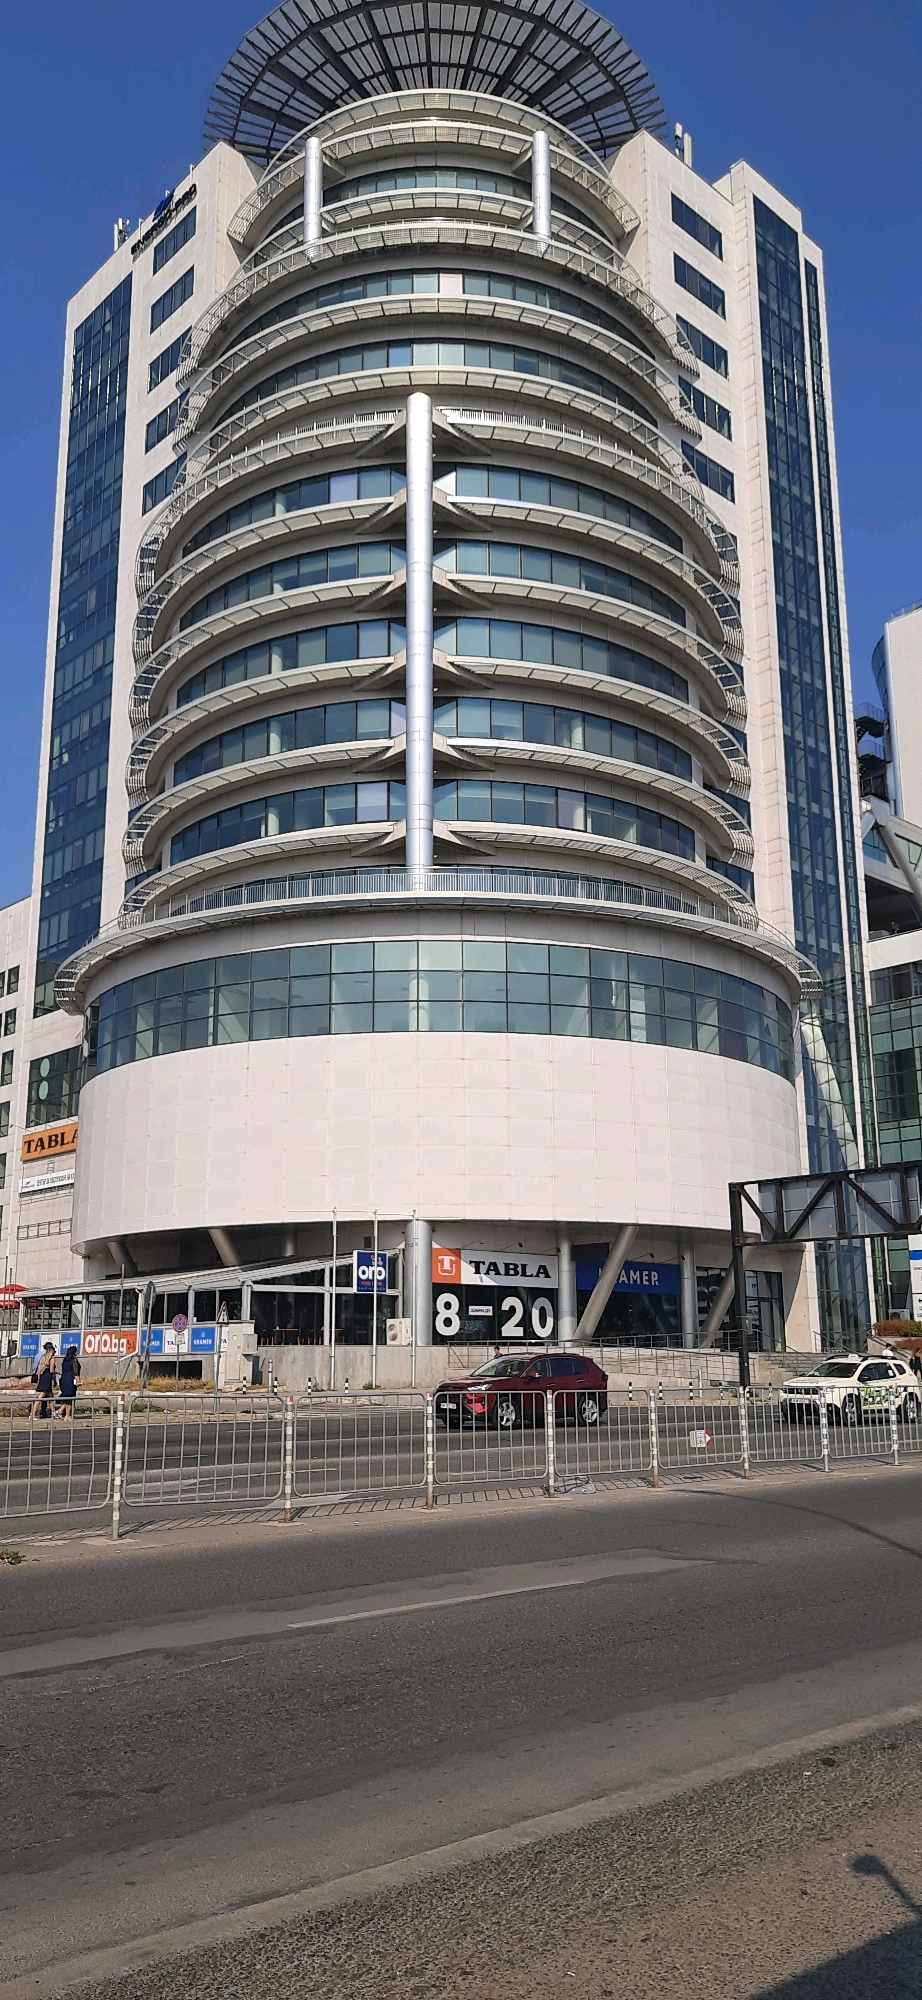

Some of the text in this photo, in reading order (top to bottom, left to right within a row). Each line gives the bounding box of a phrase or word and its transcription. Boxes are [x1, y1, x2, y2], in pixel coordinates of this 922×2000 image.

[469, 1260, 552, 1279] TABLA
[435, 1292, 554, 1338] 8 20
[193, 1338, 213, 1346] KRAMER
